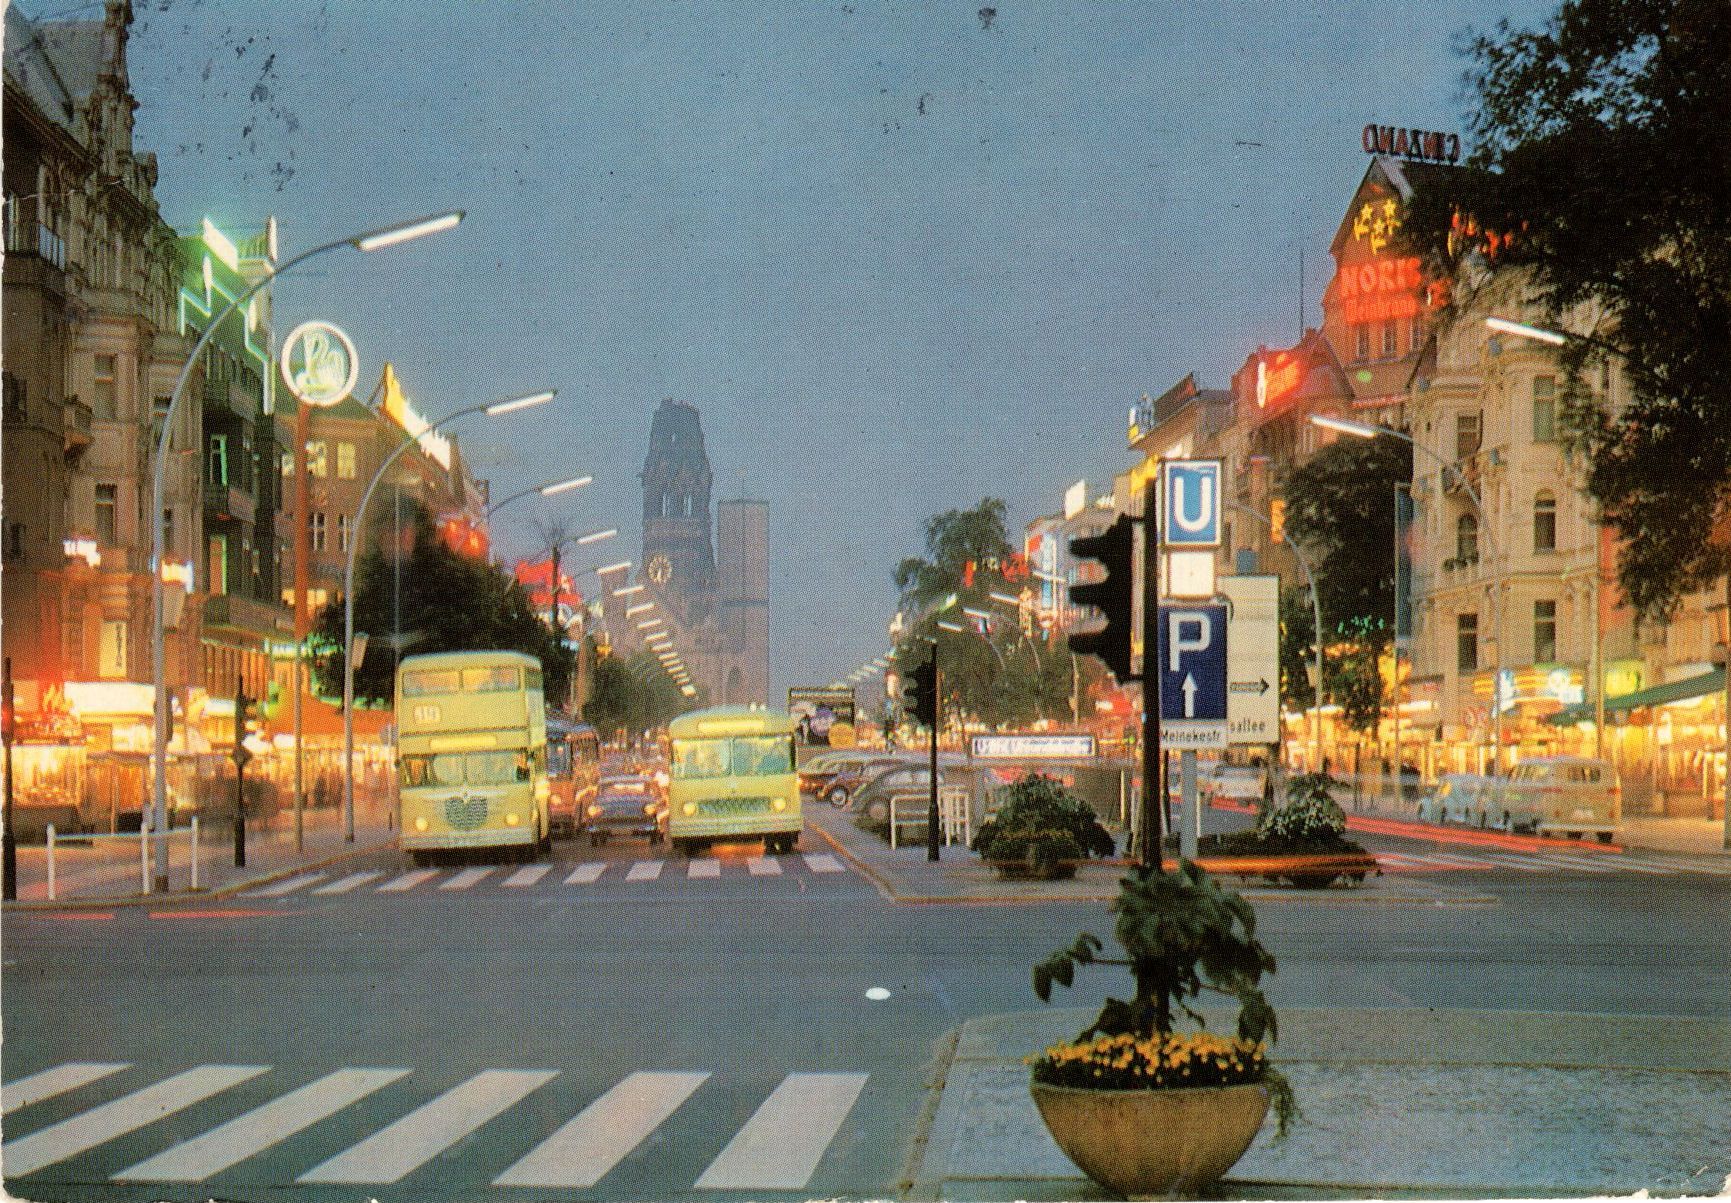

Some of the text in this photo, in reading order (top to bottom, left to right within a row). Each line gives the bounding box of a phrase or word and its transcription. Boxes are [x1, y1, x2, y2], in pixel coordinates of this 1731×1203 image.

[1340, 257, 1422, 298] NORIS
[1173, 477, 1212, 532] U
[1168, 612, 1211, 673] P
